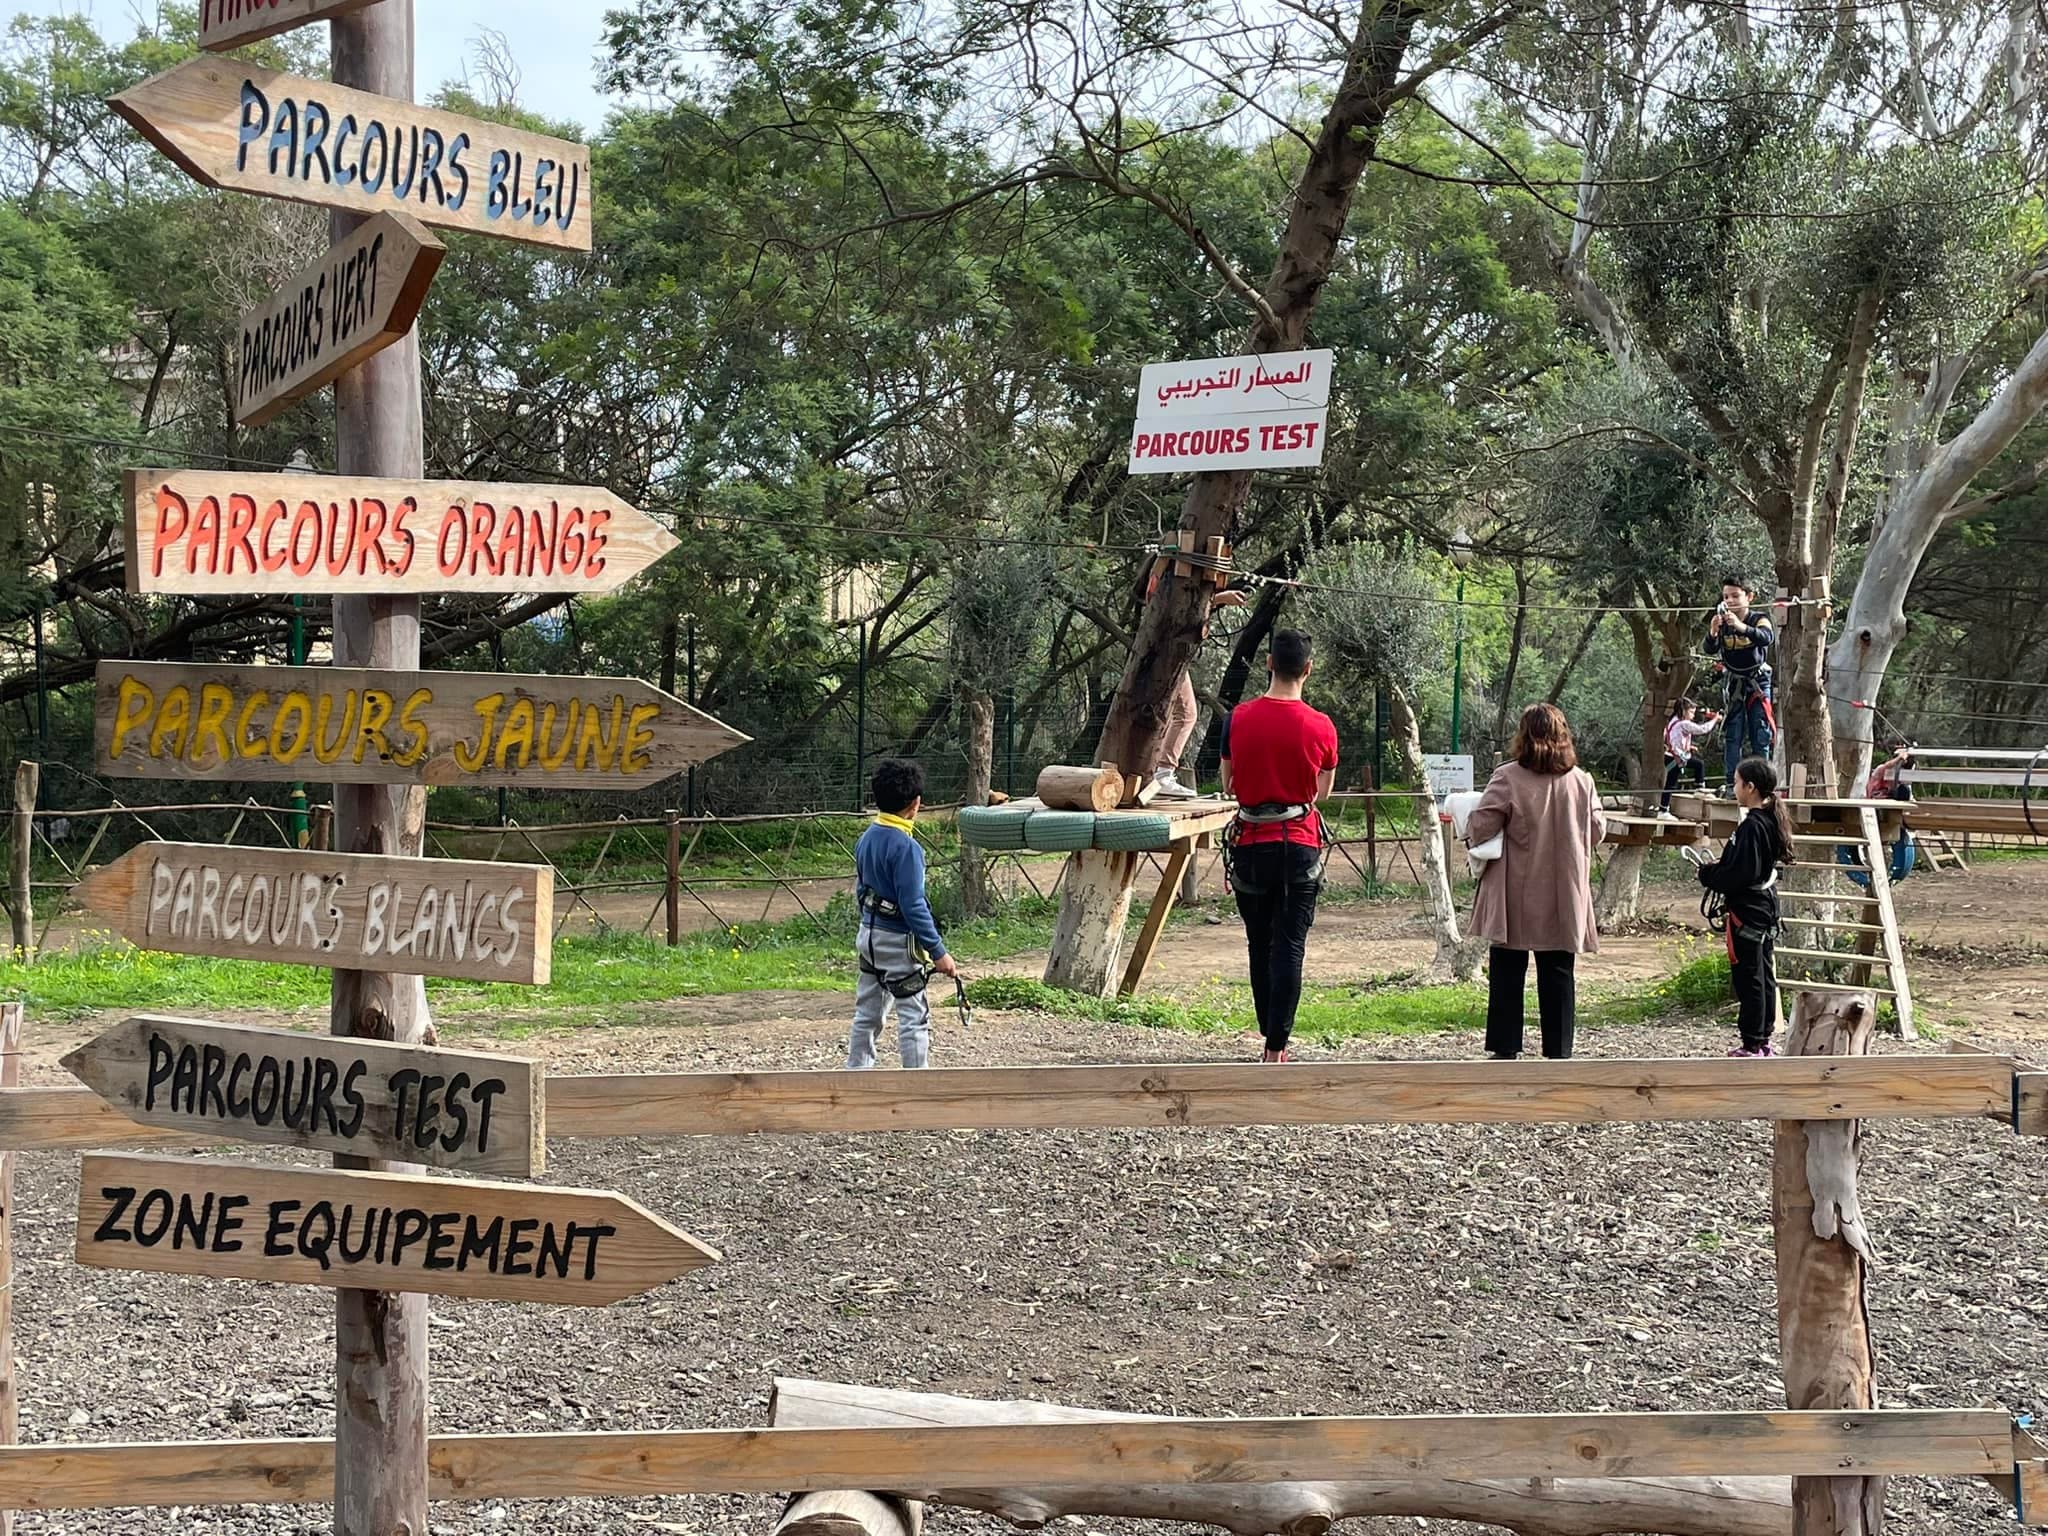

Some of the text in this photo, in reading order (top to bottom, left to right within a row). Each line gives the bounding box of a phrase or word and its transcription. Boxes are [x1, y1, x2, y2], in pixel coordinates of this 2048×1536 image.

[237, 79, 578, 231] PARCOURS BLEU
[239, 232, 383, 407] PARCOURS VERT
[1158, 362, 1312, 408] المسار التجريبي
[1135, 423, 1319, 458] PARCOURS TEST
[152, 484, 612, 578] PARCOURS ORANGE
[109, 674, 661, 774] PARCOURS JAUNE
[147, 857, 524, 966] PARCOURS BLANCS
[145, 1033, 506, 1154] PARCOURS TEST
[94, 1187, 616, 1281] ZONE EQUIPEMENT
